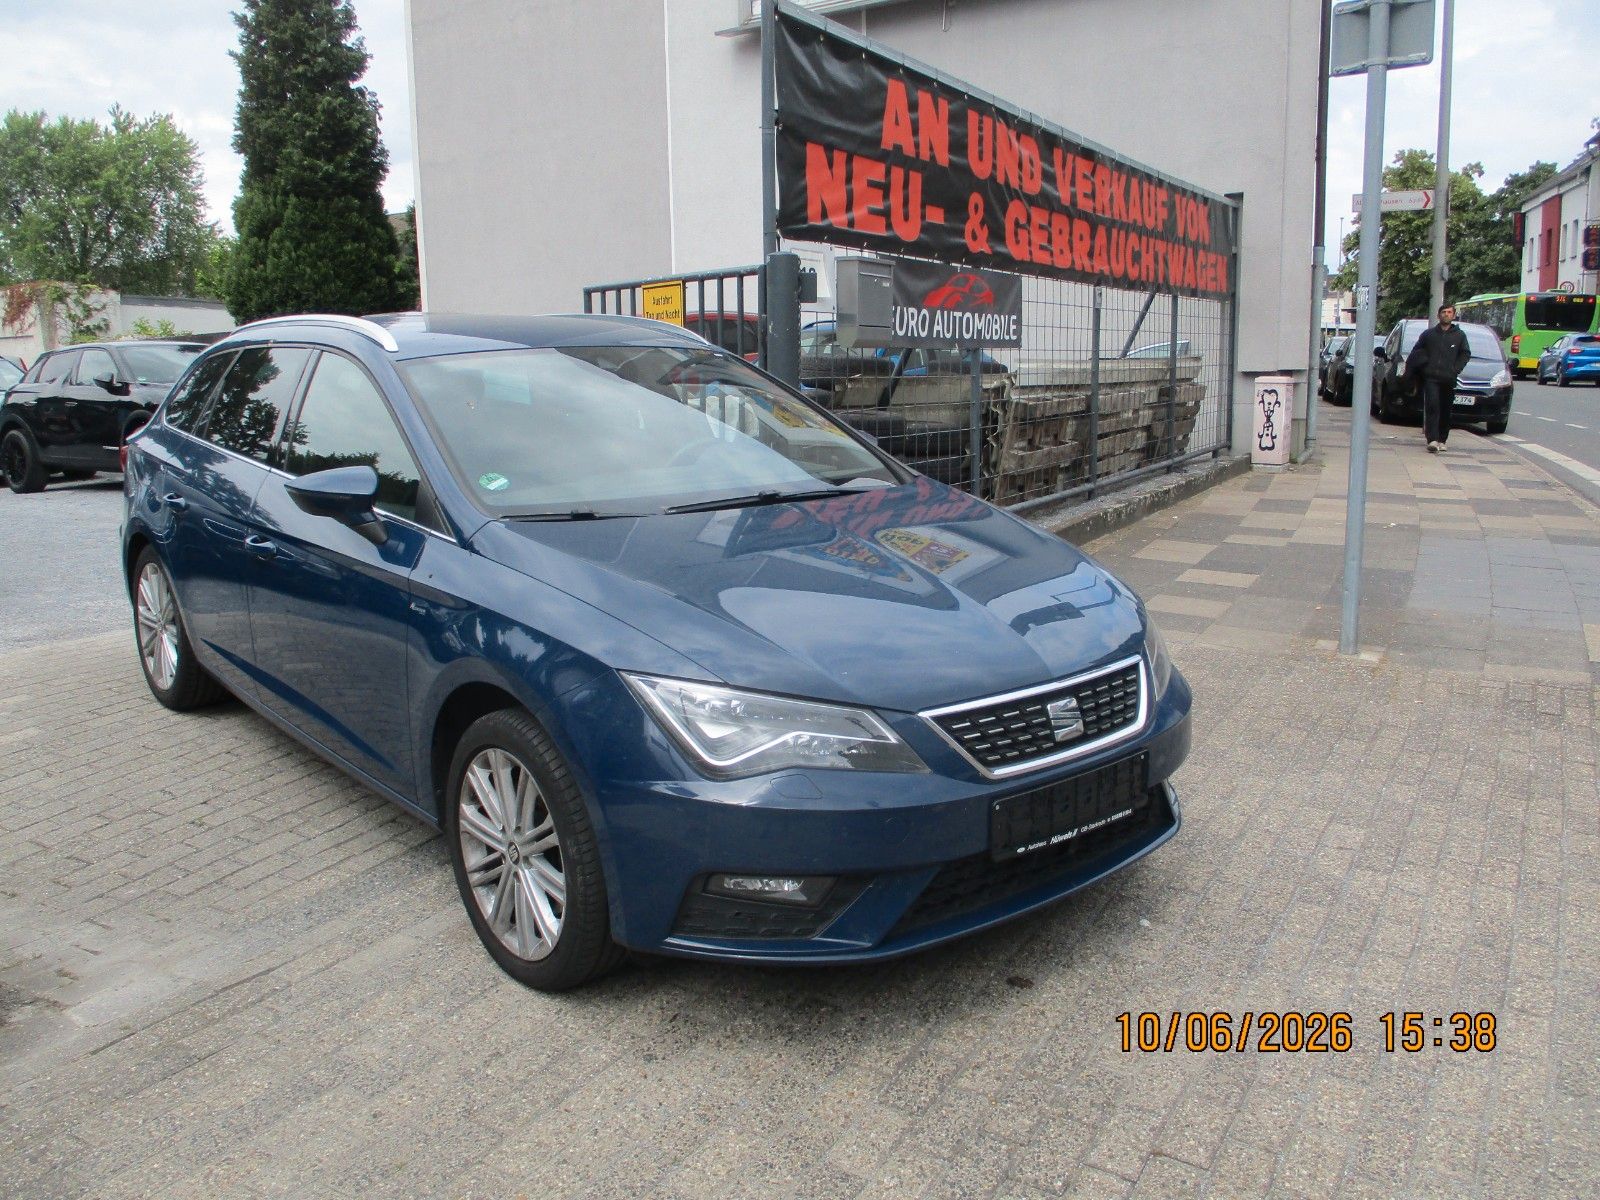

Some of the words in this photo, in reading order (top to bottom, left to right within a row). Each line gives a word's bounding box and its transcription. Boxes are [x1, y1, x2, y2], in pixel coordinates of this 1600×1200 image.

[880, 78, 949, 168] AN
[967, 108, 1043, 195] UND
[1053, 147, 1168, 232] VERKAUF
[805, 141, 945, 242] NEU-
[964, 192, 993, 255] &
[1005, 199, 1228, 293] GEBRAUCHTWAGEN
[652, 295, 672, 305] Ausfahrt
[656, 310, 665, 320] und
[665, 309, 681, 319] Nacht
[892, 305, 929, 338] URO
[933, 309, 1018, 340] AUTOMOBILE
